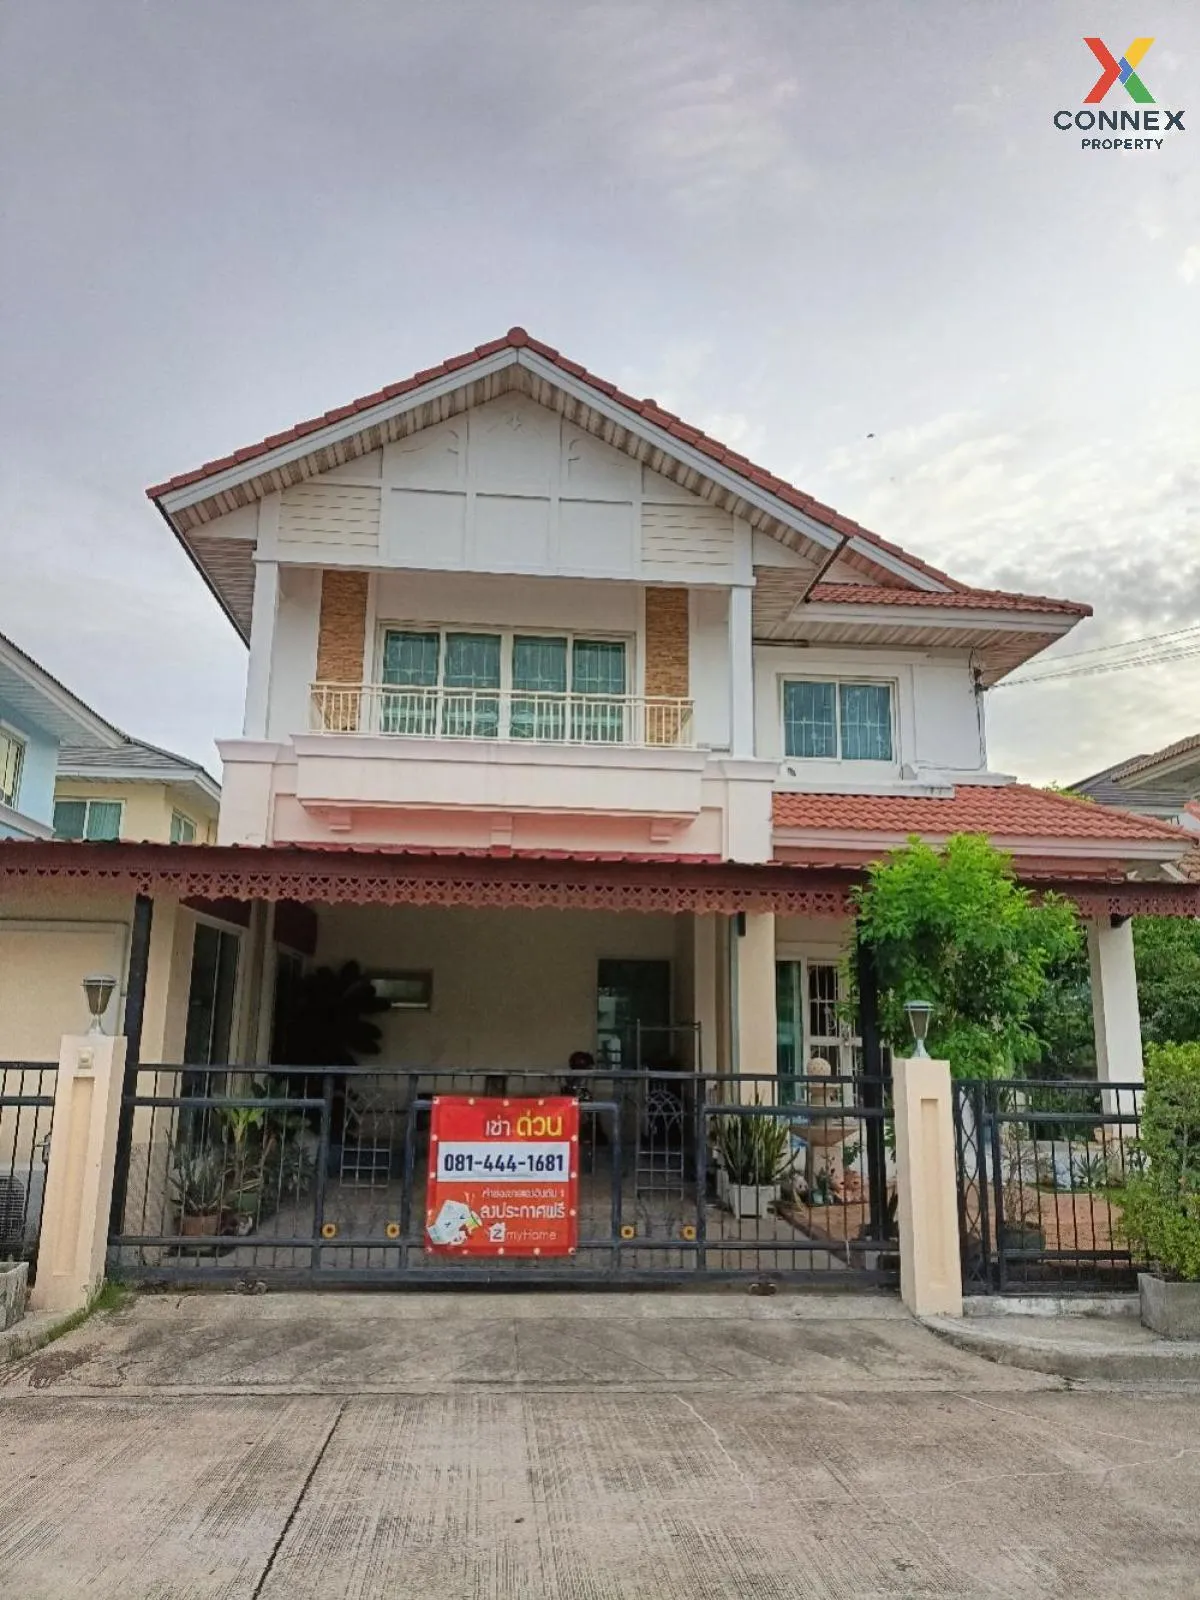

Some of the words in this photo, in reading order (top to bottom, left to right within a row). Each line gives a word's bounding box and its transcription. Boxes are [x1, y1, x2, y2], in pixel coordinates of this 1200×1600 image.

[485, 1114, 511, 1137] เช่า
[516, 1110, 563, 1137] ด่วน
[443, 1153, 564, 1172] 081-444-1681
[480, 1202, 566, 1219] ลงประกาศฟรี
